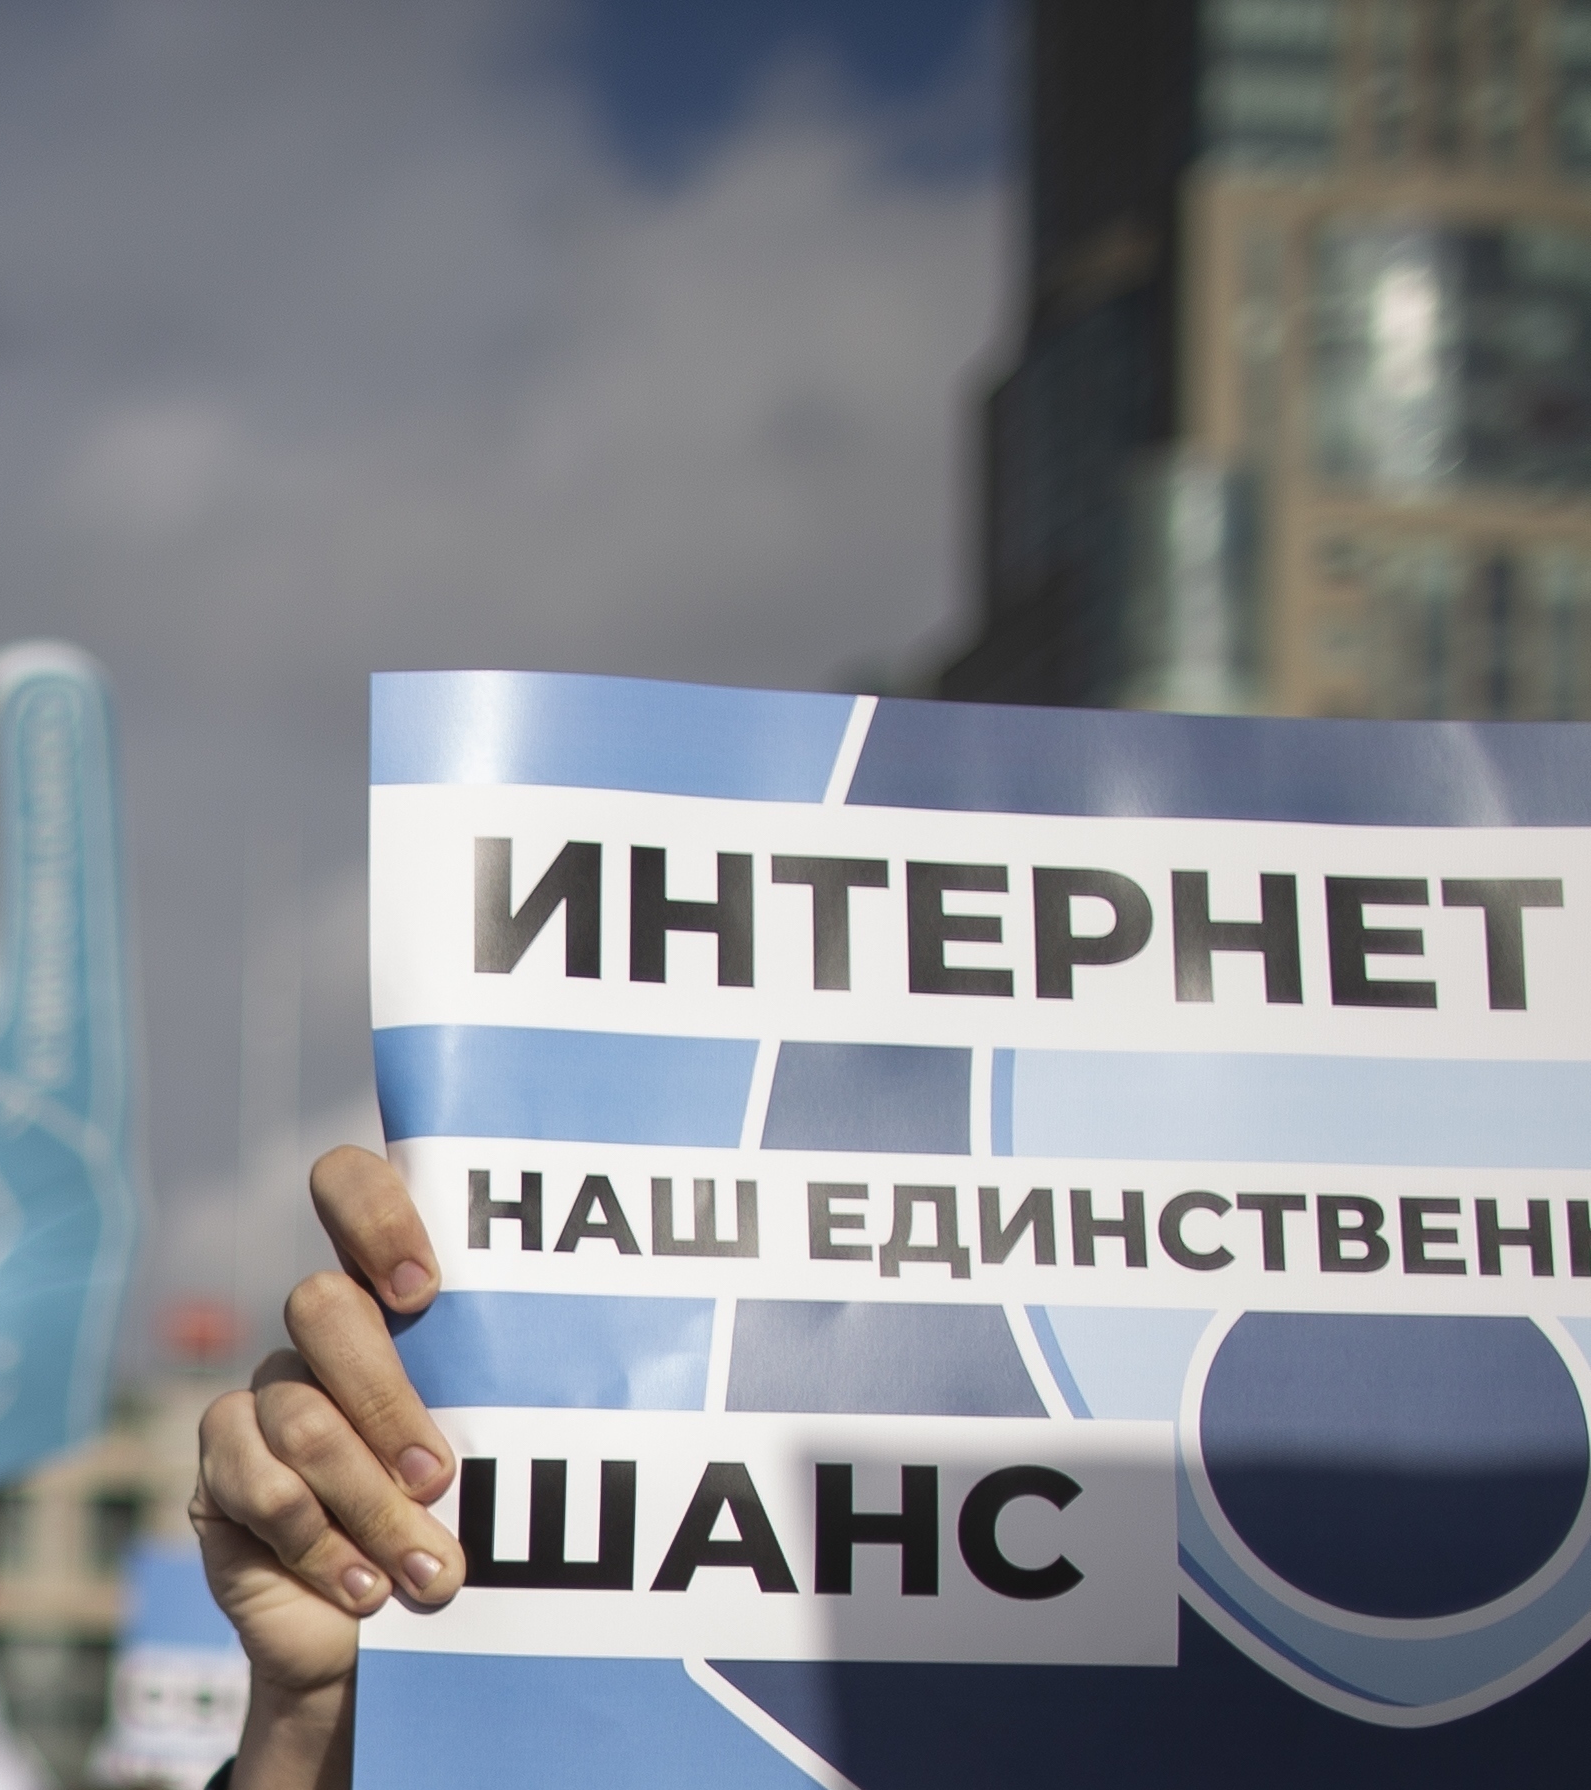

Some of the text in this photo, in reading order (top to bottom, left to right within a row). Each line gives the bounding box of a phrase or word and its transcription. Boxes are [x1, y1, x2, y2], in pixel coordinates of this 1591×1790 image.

[474, 836, 1564, 1011] ИНТЕРНЕТ
[467, 1169, 760, 1260] НАШ
[458, 1457, 1084, 1602] ШАНС
